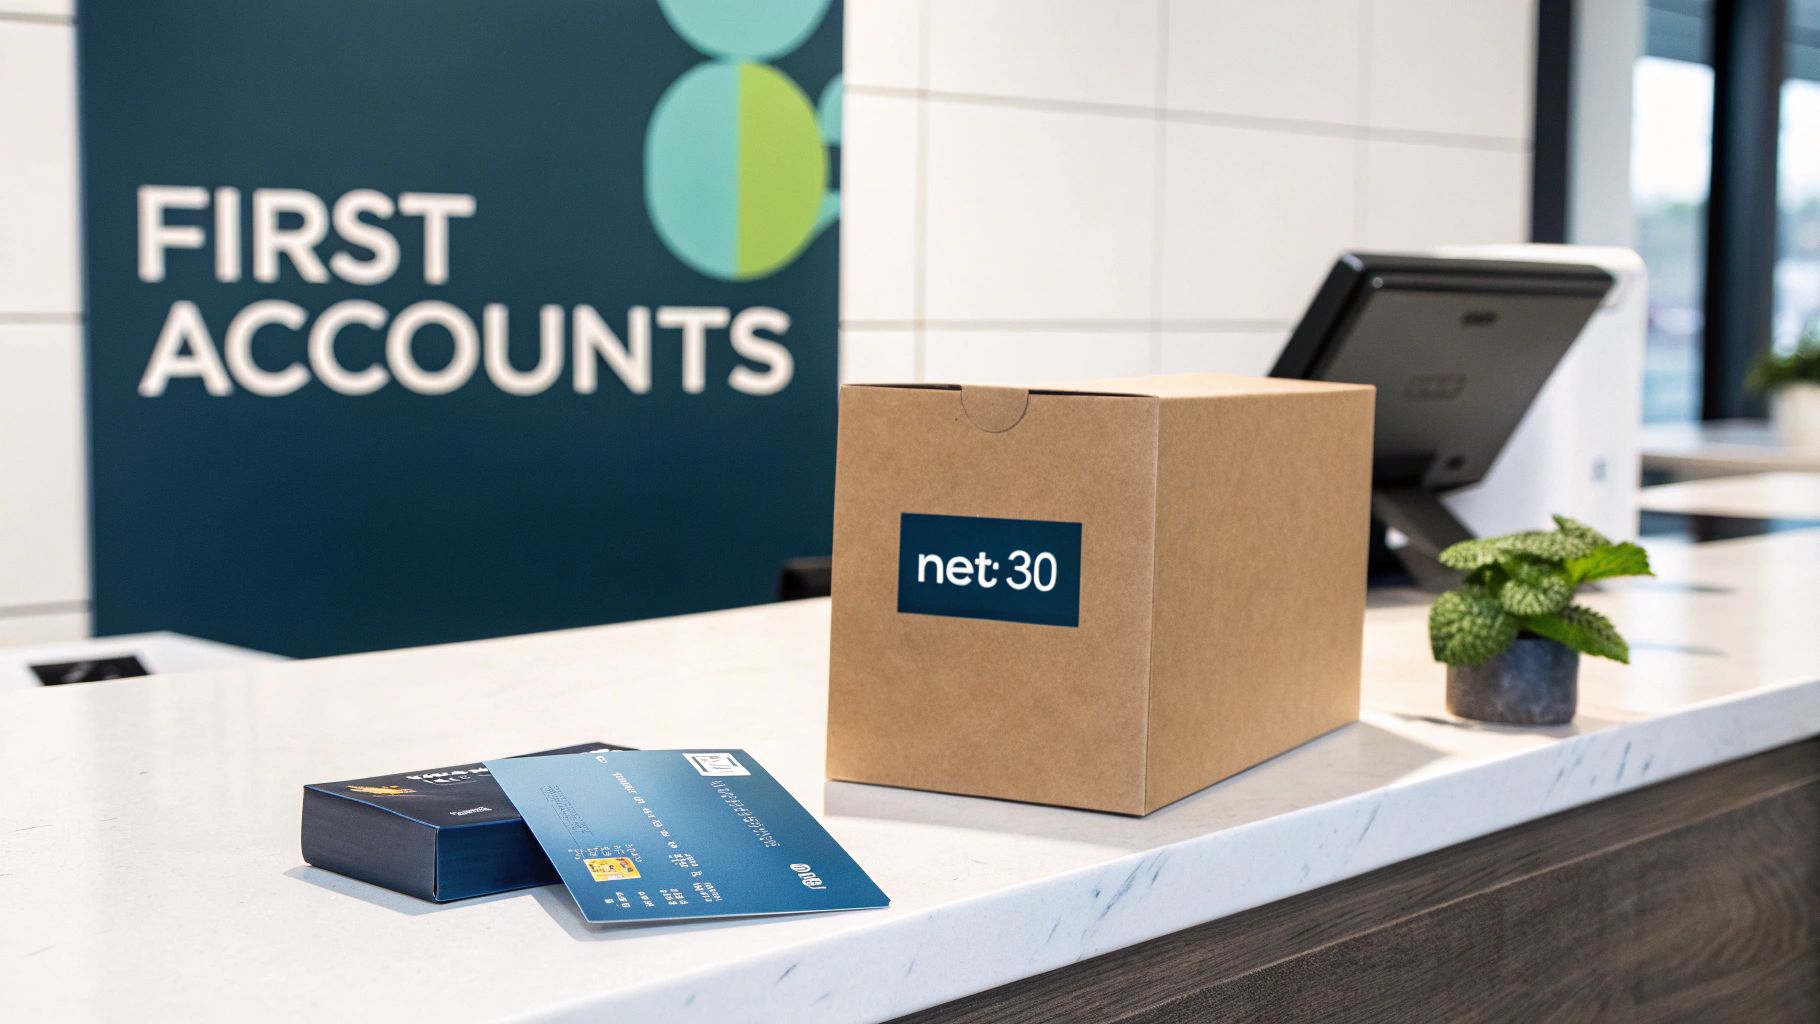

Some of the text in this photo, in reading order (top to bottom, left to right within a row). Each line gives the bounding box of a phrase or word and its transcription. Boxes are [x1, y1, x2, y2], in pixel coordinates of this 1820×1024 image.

[136, 184, 477, 286] FIRST
[137, 299, 795, 398] ACCOUNTS
[1005, 549, 1058, 592] 30
